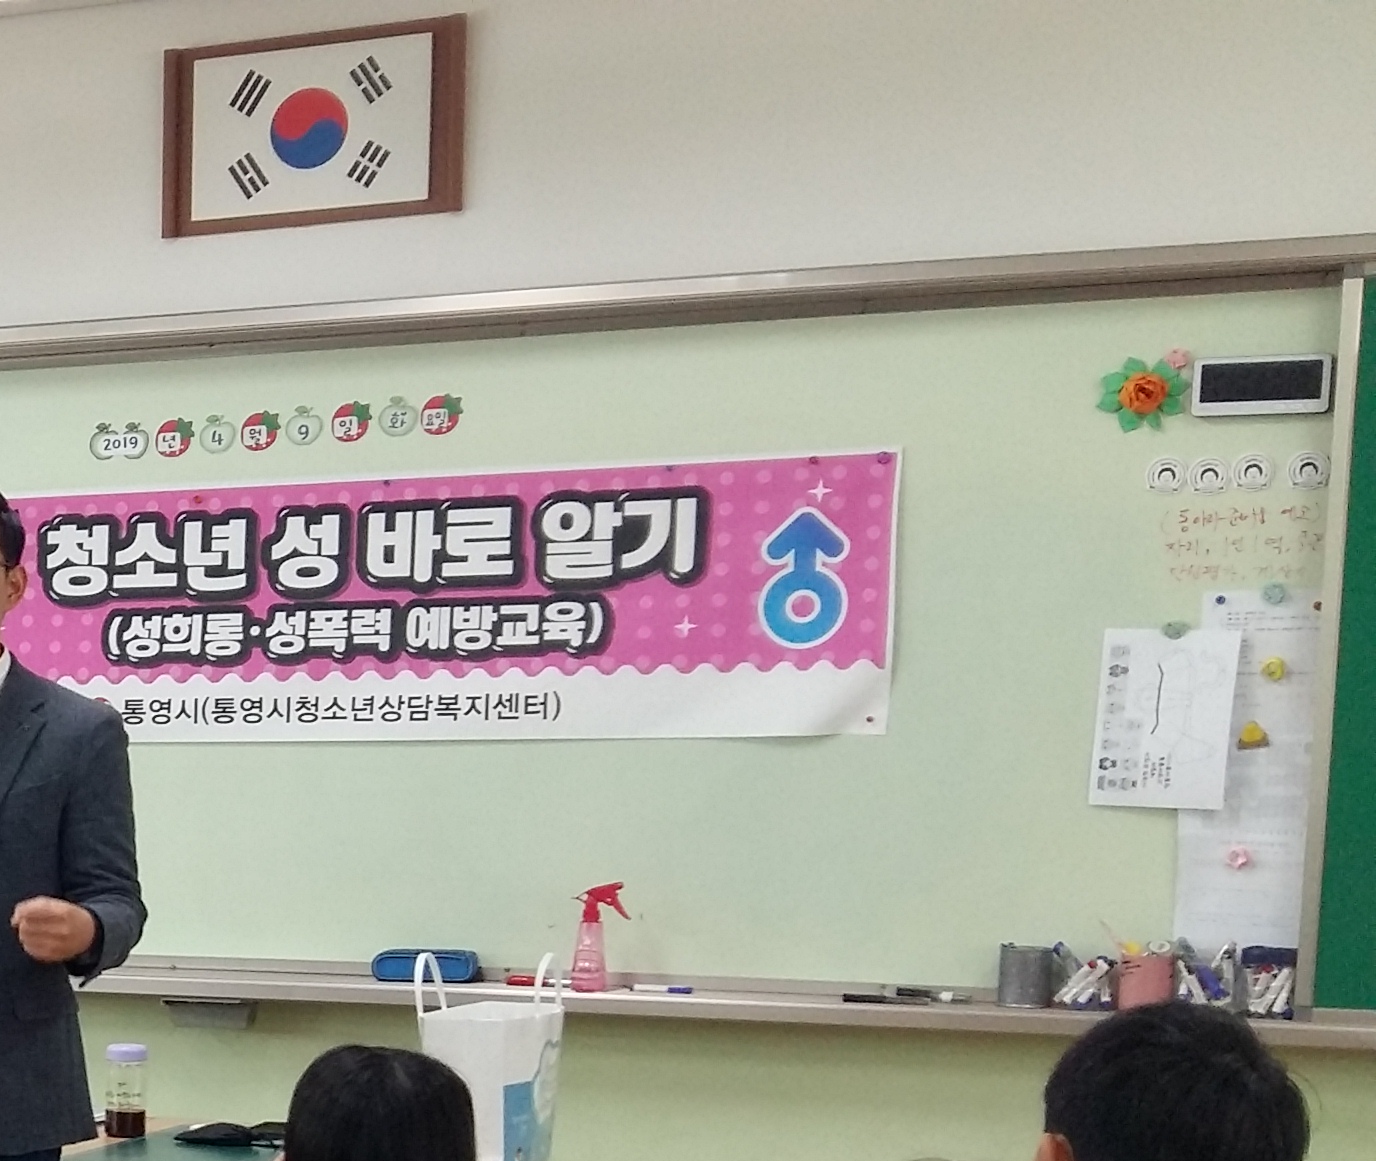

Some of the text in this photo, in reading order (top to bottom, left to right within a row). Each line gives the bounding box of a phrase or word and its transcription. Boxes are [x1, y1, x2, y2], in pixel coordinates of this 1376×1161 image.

[102, 435, 139, 451] 2019
[45, 496, 698, 598] 청소년 성 바로 알기
[405, 600, 604, 656] 예방교육)
[121, 690, 562, 727] 통영시(통영시청소년상담복지센터)
